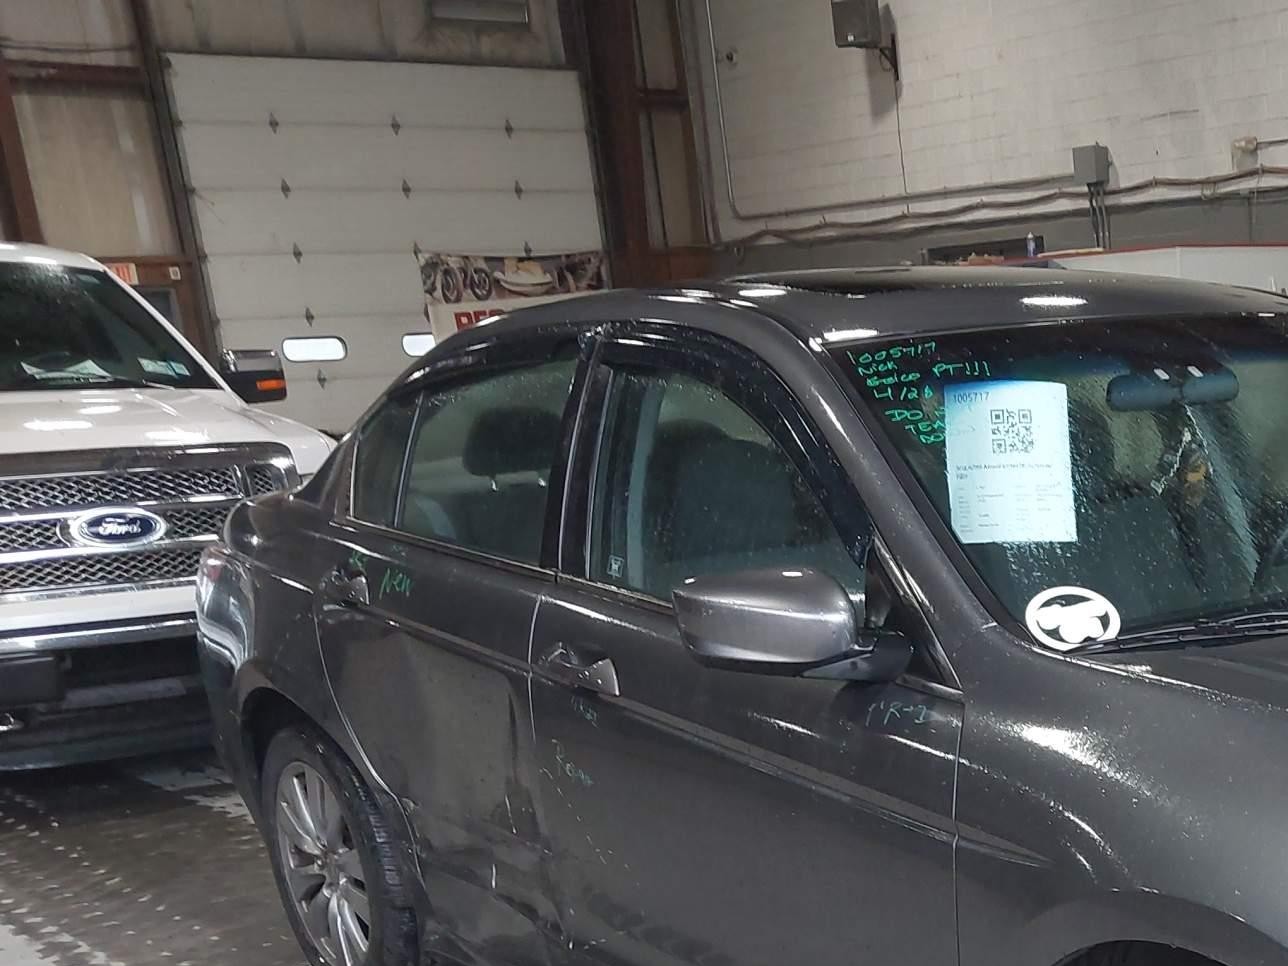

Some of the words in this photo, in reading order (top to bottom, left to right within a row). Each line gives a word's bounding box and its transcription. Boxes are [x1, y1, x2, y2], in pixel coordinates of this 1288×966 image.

[847, 341, 936, 365] 1005717
[953, 391, 990, 403] 1005717
[905, 420, 946, 435] TEA
[98, 518, 142, 536] Ford
